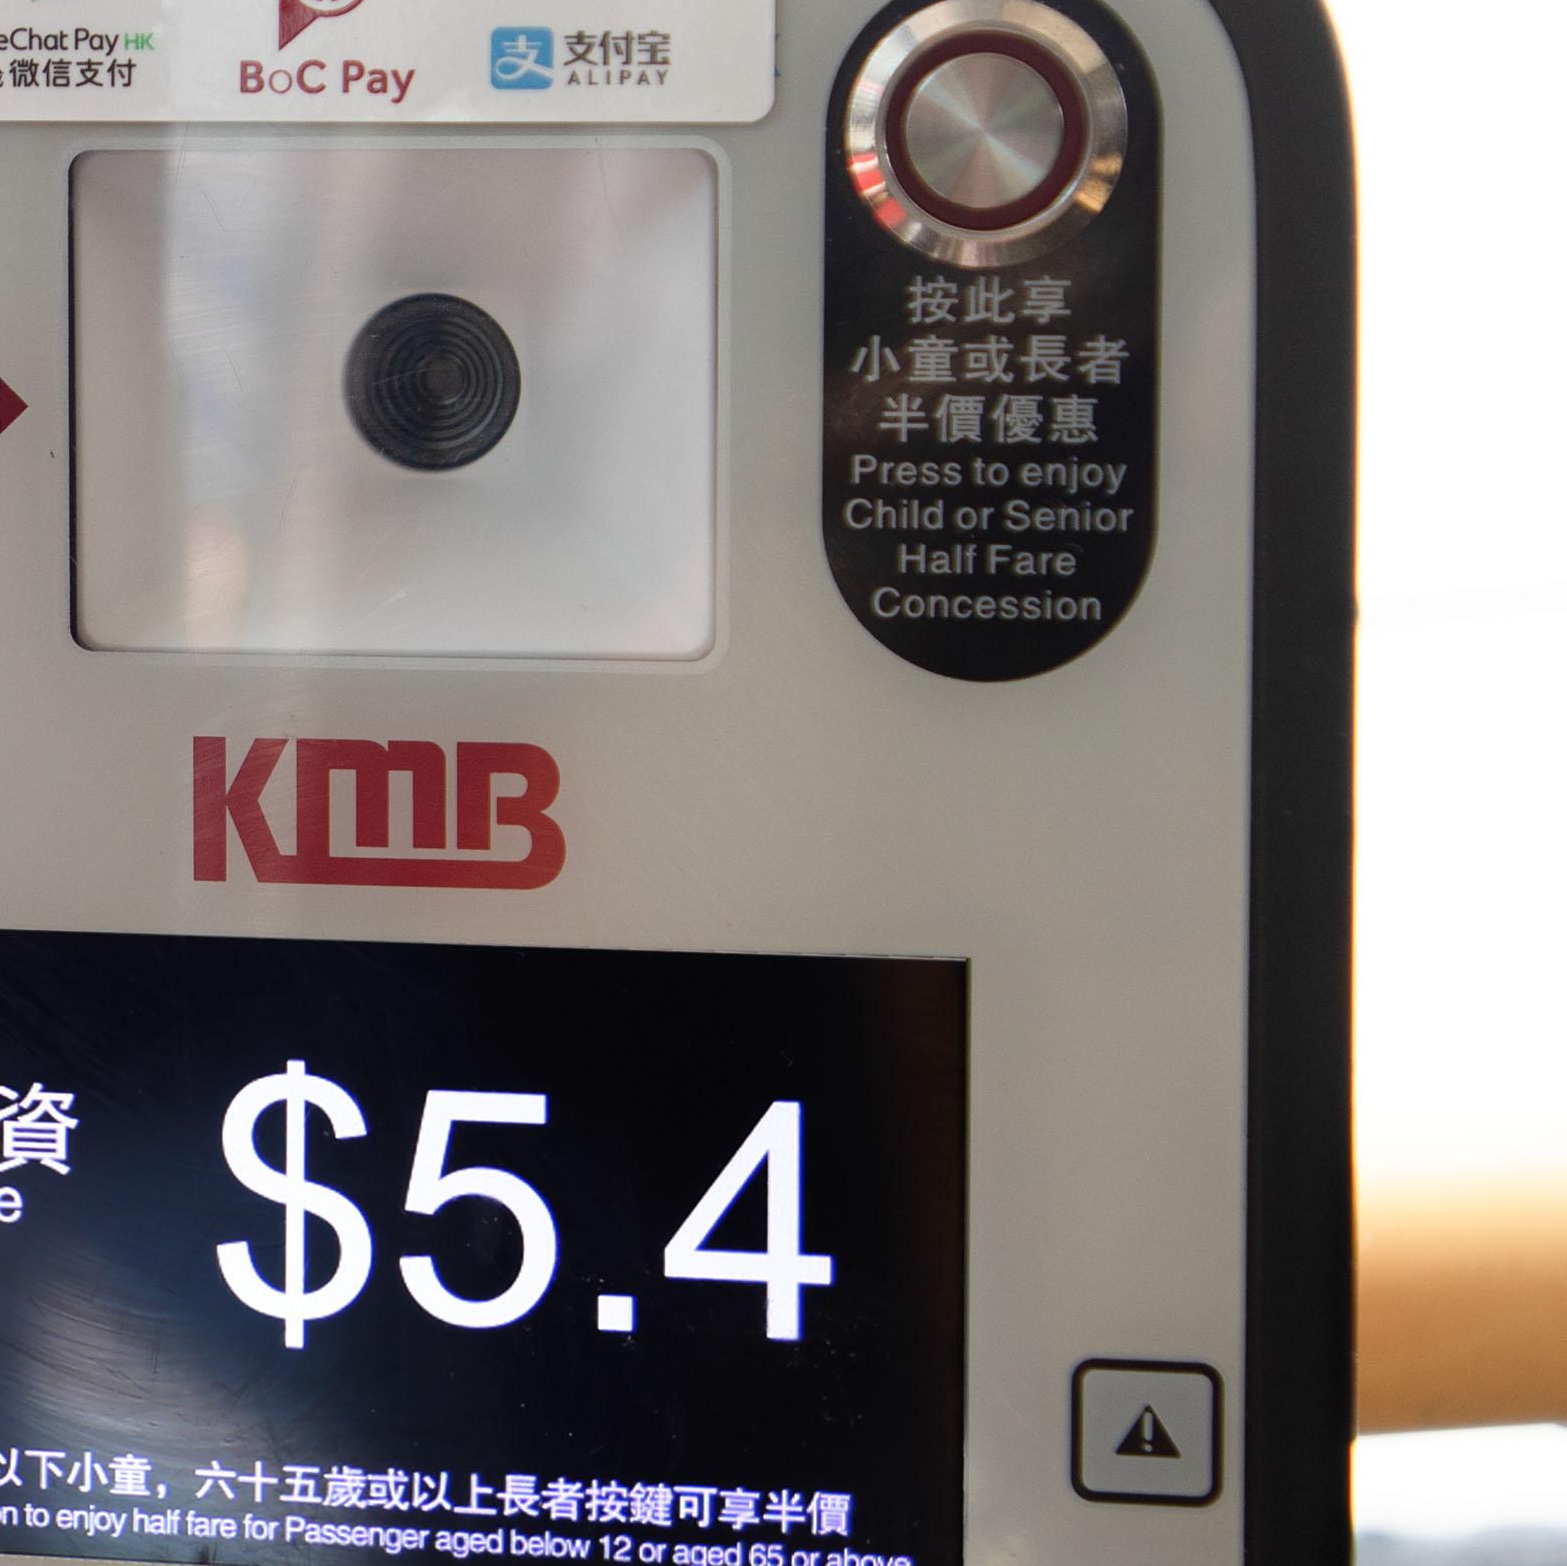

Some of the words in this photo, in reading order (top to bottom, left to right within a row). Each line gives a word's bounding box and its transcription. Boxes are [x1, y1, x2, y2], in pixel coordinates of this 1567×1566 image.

[74, 28, 120, 58] Pay
[124, 32, 154, 51] HK
[563, 29, 672, 67] 支付宝
[342, 60, 417, 104] Pay
[566, 69, 669, 86] ALIPAY
[907, 274, 1072, 324] 按此享
[849, 334, 1130, 384] 小童或長者
[879, 393, 1099, 443] 半價優惠
[852, 454, 963, 485] Press
[975, 457, 1010, 486] to
[1021, 457, 1127, 496] enjoy
[844, 498, 944, 530] Child
[956, 505, 994, 531] or
[1003, 499, 1134, 532] Senior
[898, 543, 977, 575] Half
[988, 544, 1077, 576] Fare
[872, 587, 1102, 621] Concession
[192, 735, 567, 891] KMB
[215, 1059, 835, 1349] $5.4
[25, 1501, 50, 1528] to
[56, 1503, 127, 1538] enjoy
[133, 1507, 183, 1536] half
[187, 1510, 237, 1539] fare
[243, 1513, 280, 1541] for
[285, 1516, 430, 1554] Passenger
[435, 1527, 503, 1559] aged
[510, 1530, 590, 1560] below
[599, 1535, 631, 1563] 12
[638, 1541, 666, 1565] or
